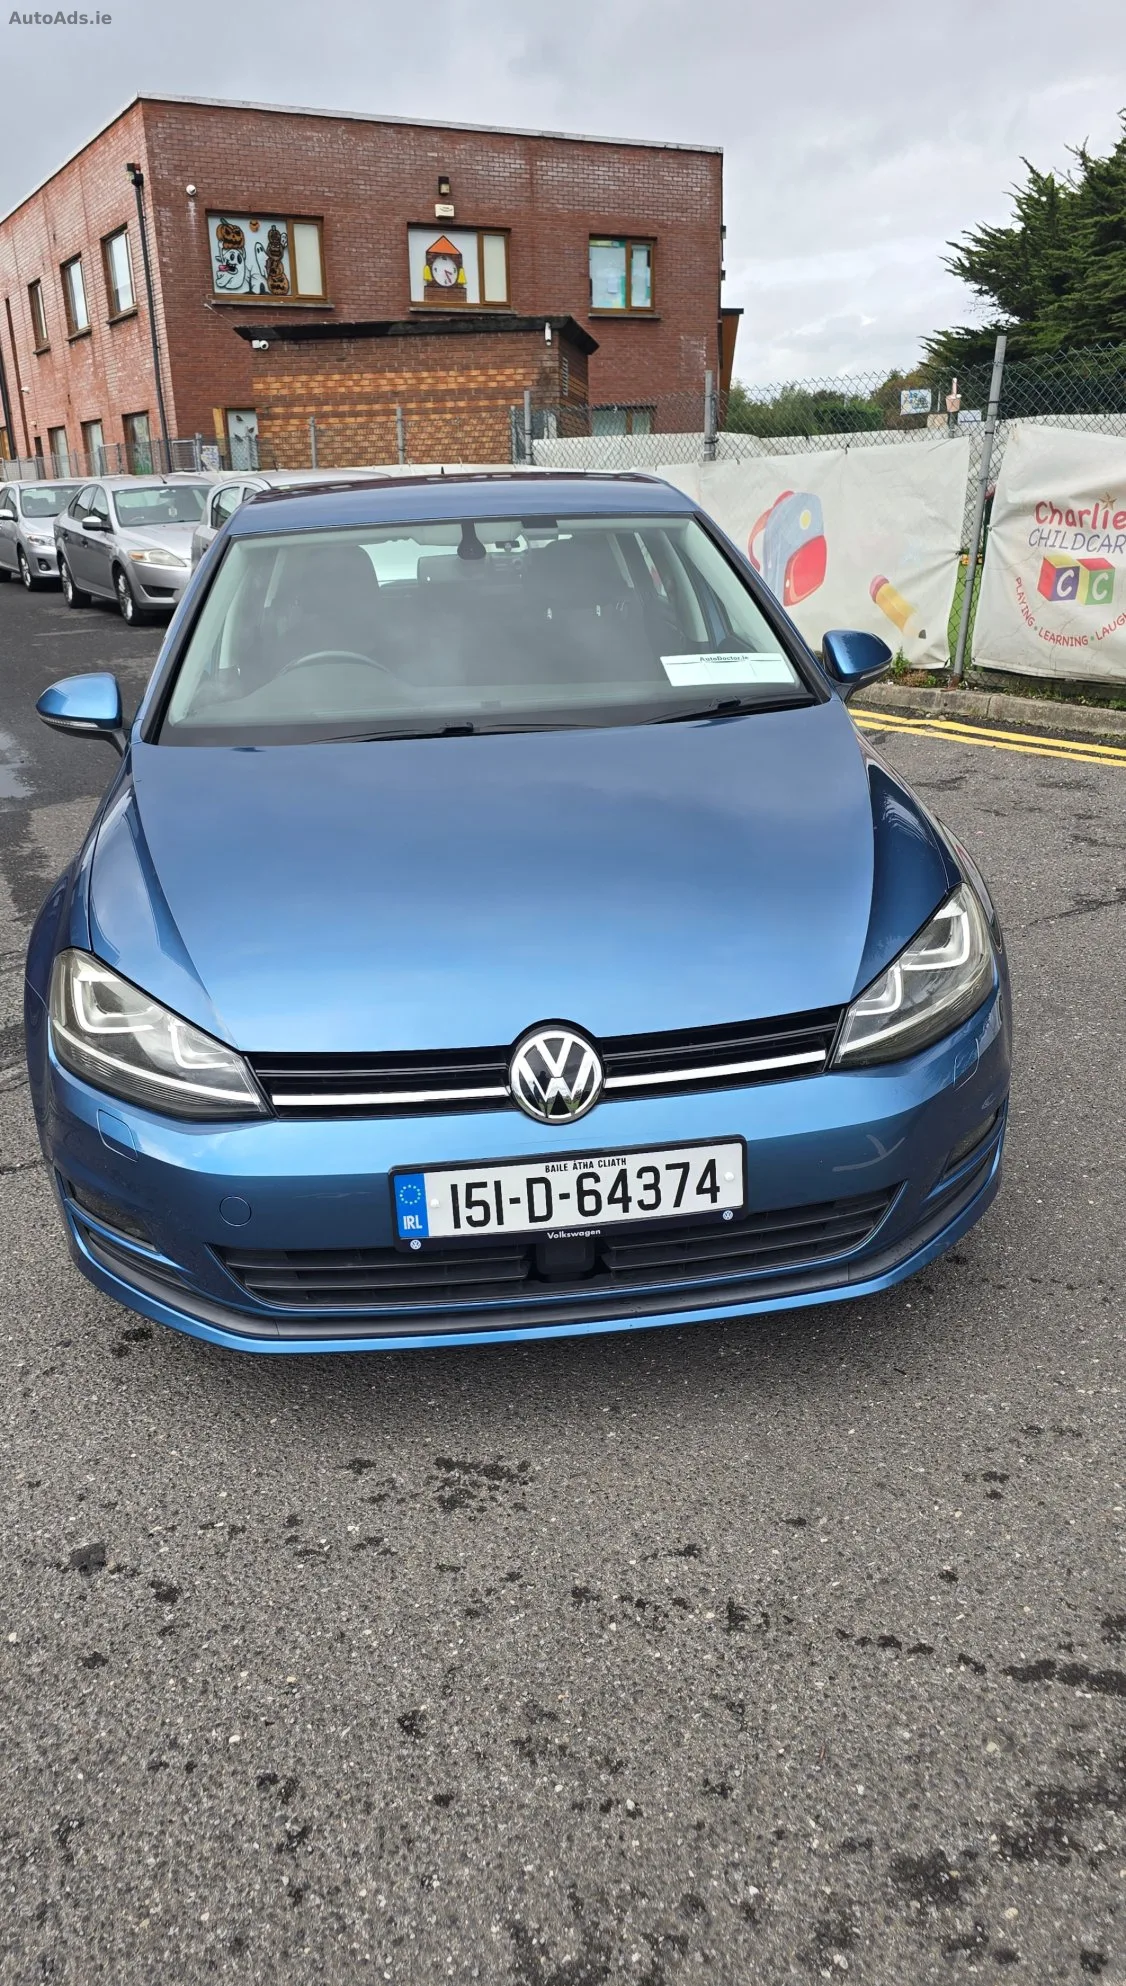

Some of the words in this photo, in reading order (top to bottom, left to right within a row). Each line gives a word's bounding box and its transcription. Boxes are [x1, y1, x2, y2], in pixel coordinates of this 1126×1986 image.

[1035, 500, 1126, 530] Charlie
[1028, 527, 1126, 554] CHILDCAR
[1056, 569, 1075, 598] C
[1091, 572, 1109, 601] C
[1015, 577, 1036, 627] PLAYING
[1038, 627, 1089, 647] LEARNING
[545, 1162, 568, 1174] BAILE
[597, 1157, 627, 1169] CLIATH
[449, 1158, 721, 1229] 151-D-64374
[402, 1214, 423, 1230] IRL
[547, 1229, 601, 1240] Volkswagen
